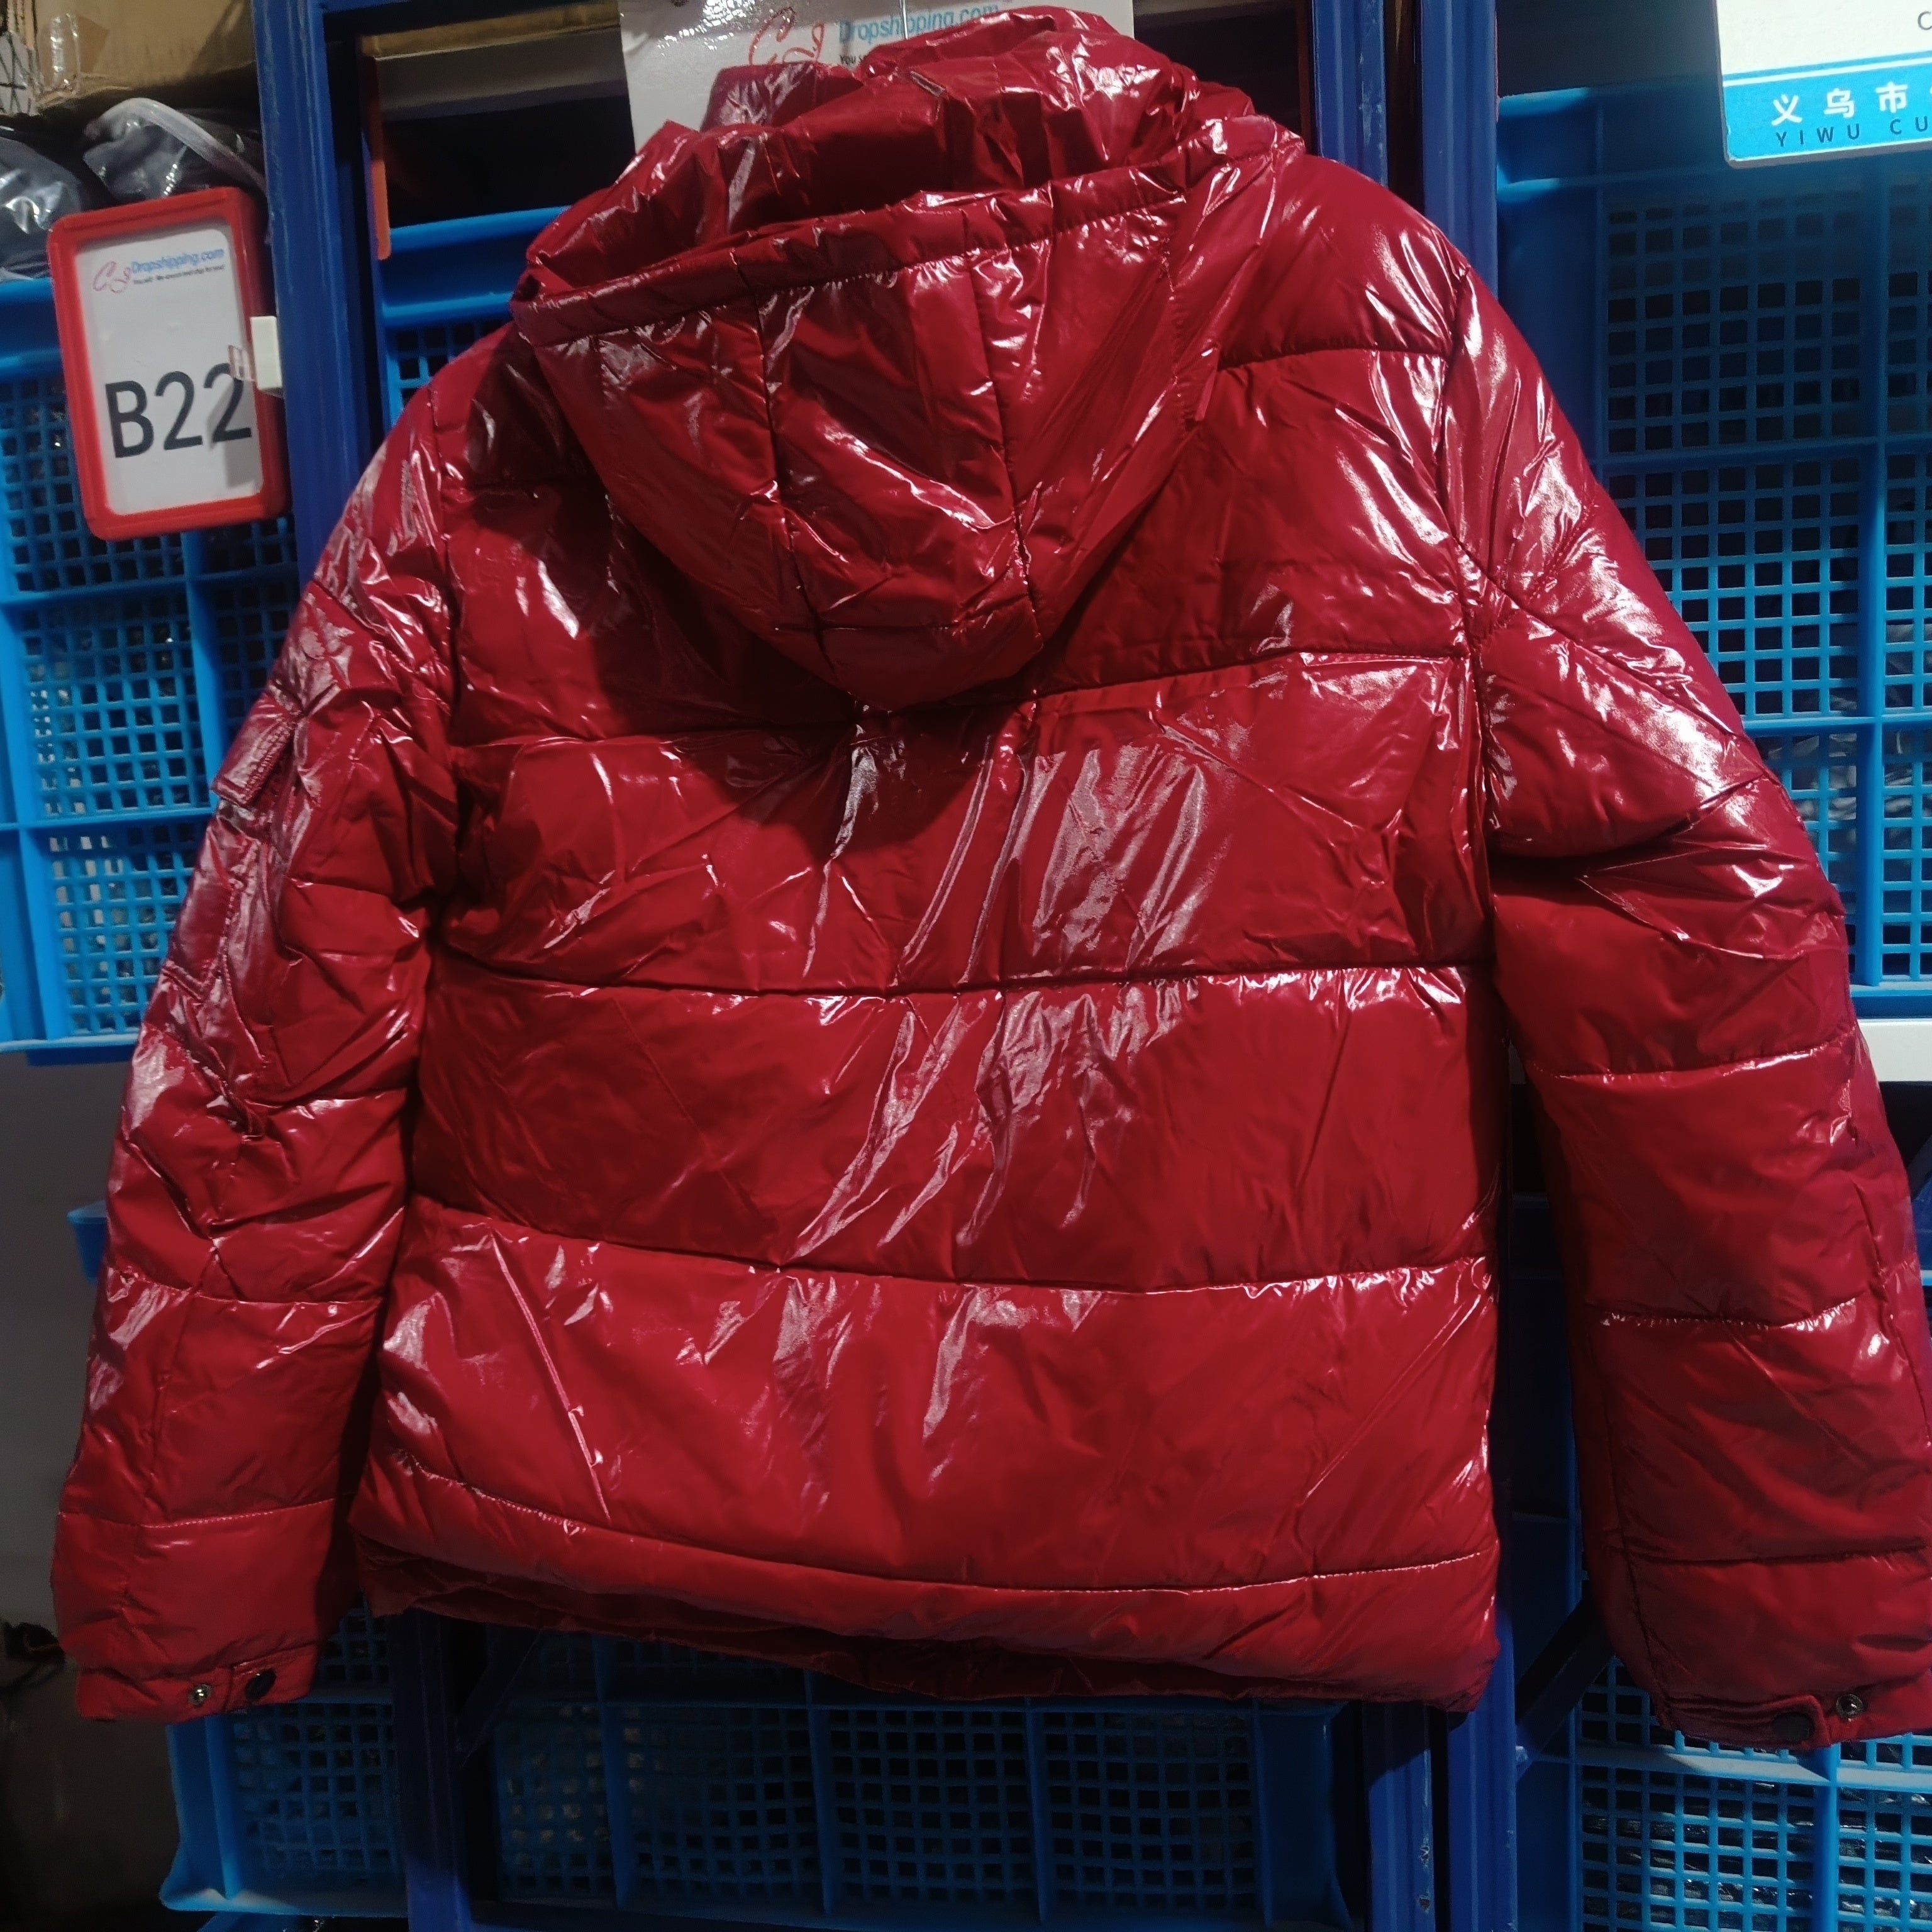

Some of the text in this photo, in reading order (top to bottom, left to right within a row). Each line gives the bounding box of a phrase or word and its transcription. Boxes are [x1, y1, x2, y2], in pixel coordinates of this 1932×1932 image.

[839, 4, 999, 45] Dropshpping.com
[1771, 81, 1932, 126] 义乌市
[1775, 116, 1929, 147] YIWU CU
[105, 363, 252, 458] B22
